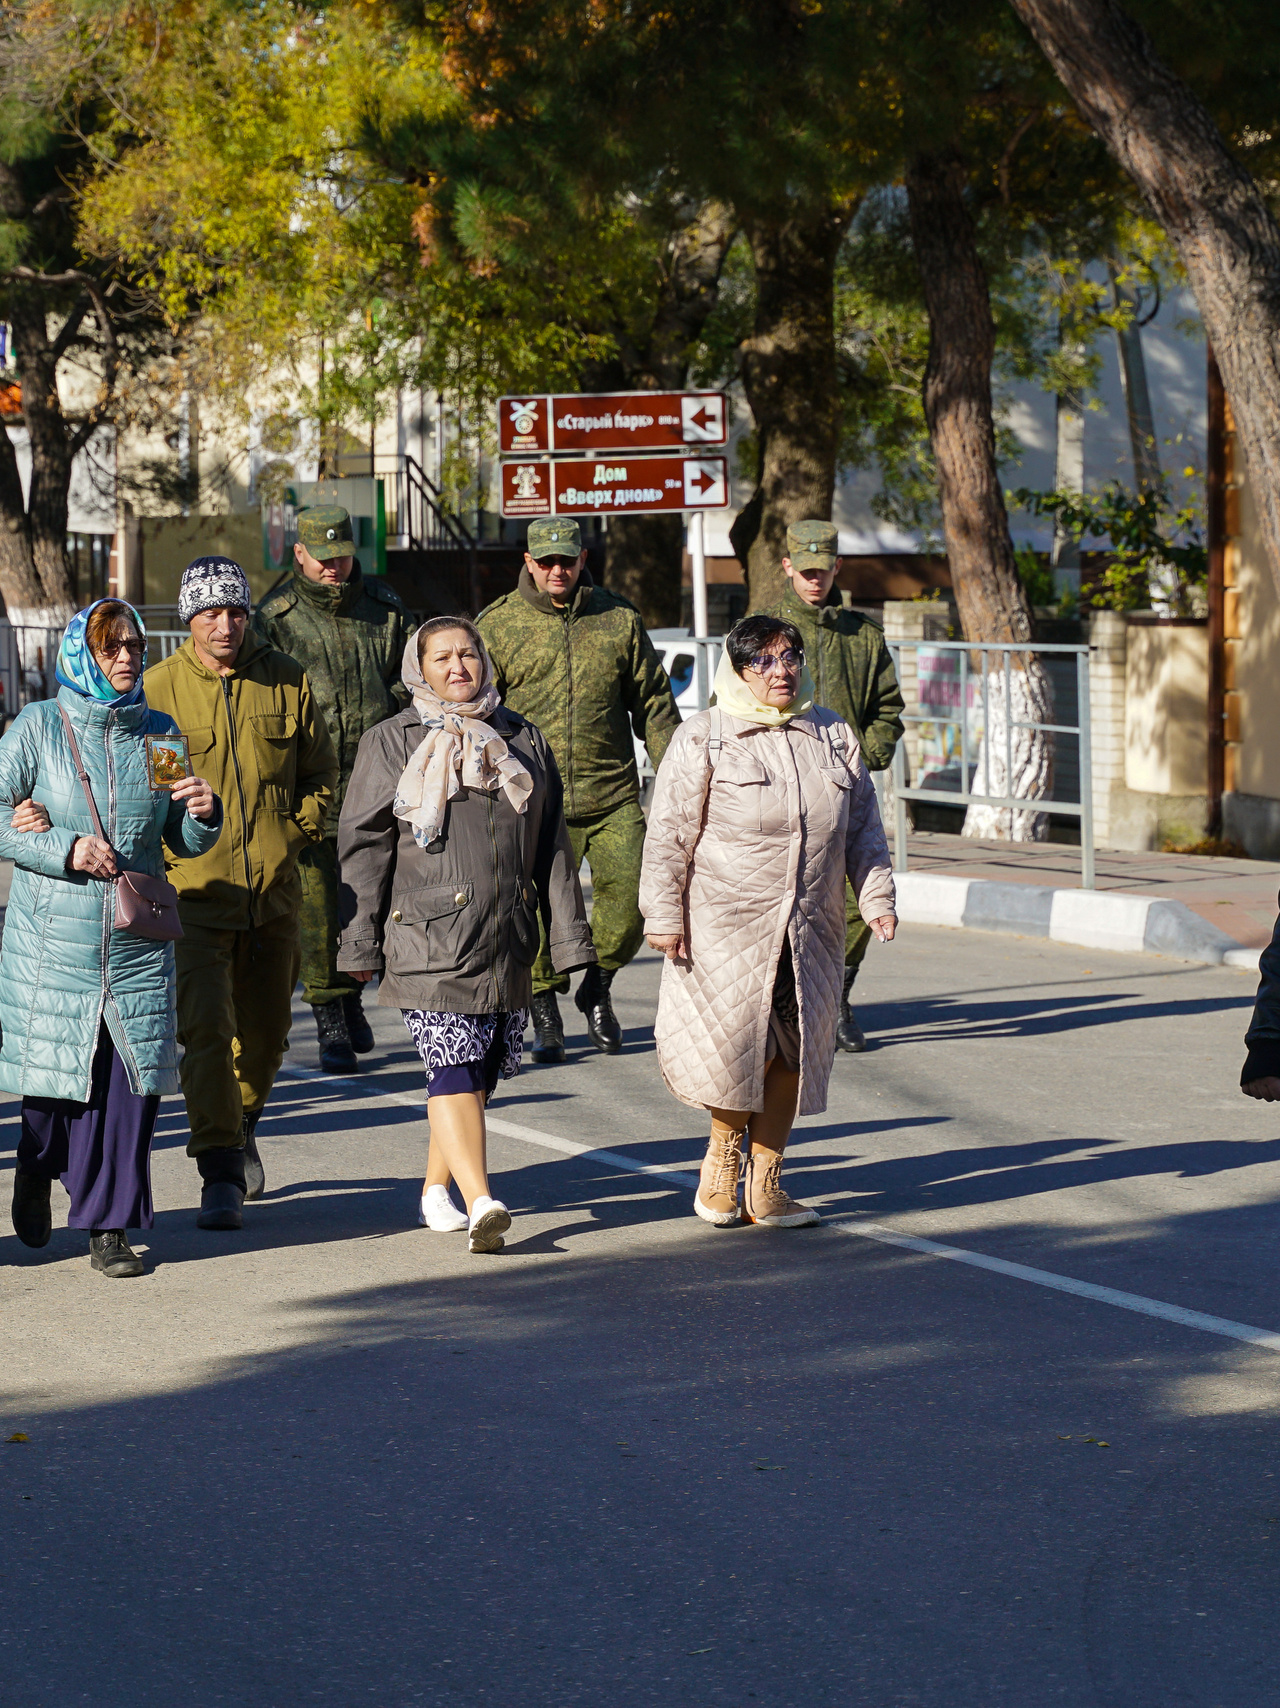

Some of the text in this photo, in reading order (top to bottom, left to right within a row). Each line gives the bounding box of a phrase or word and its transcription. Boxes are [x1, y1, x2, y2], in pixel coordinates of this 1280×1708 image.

[557, 413, 612, 432] «Старый
[593, 464, 627, 485] Дом
[558, 488, 613, 508] «Вверх
[613, 488, 663, 506] дном»
